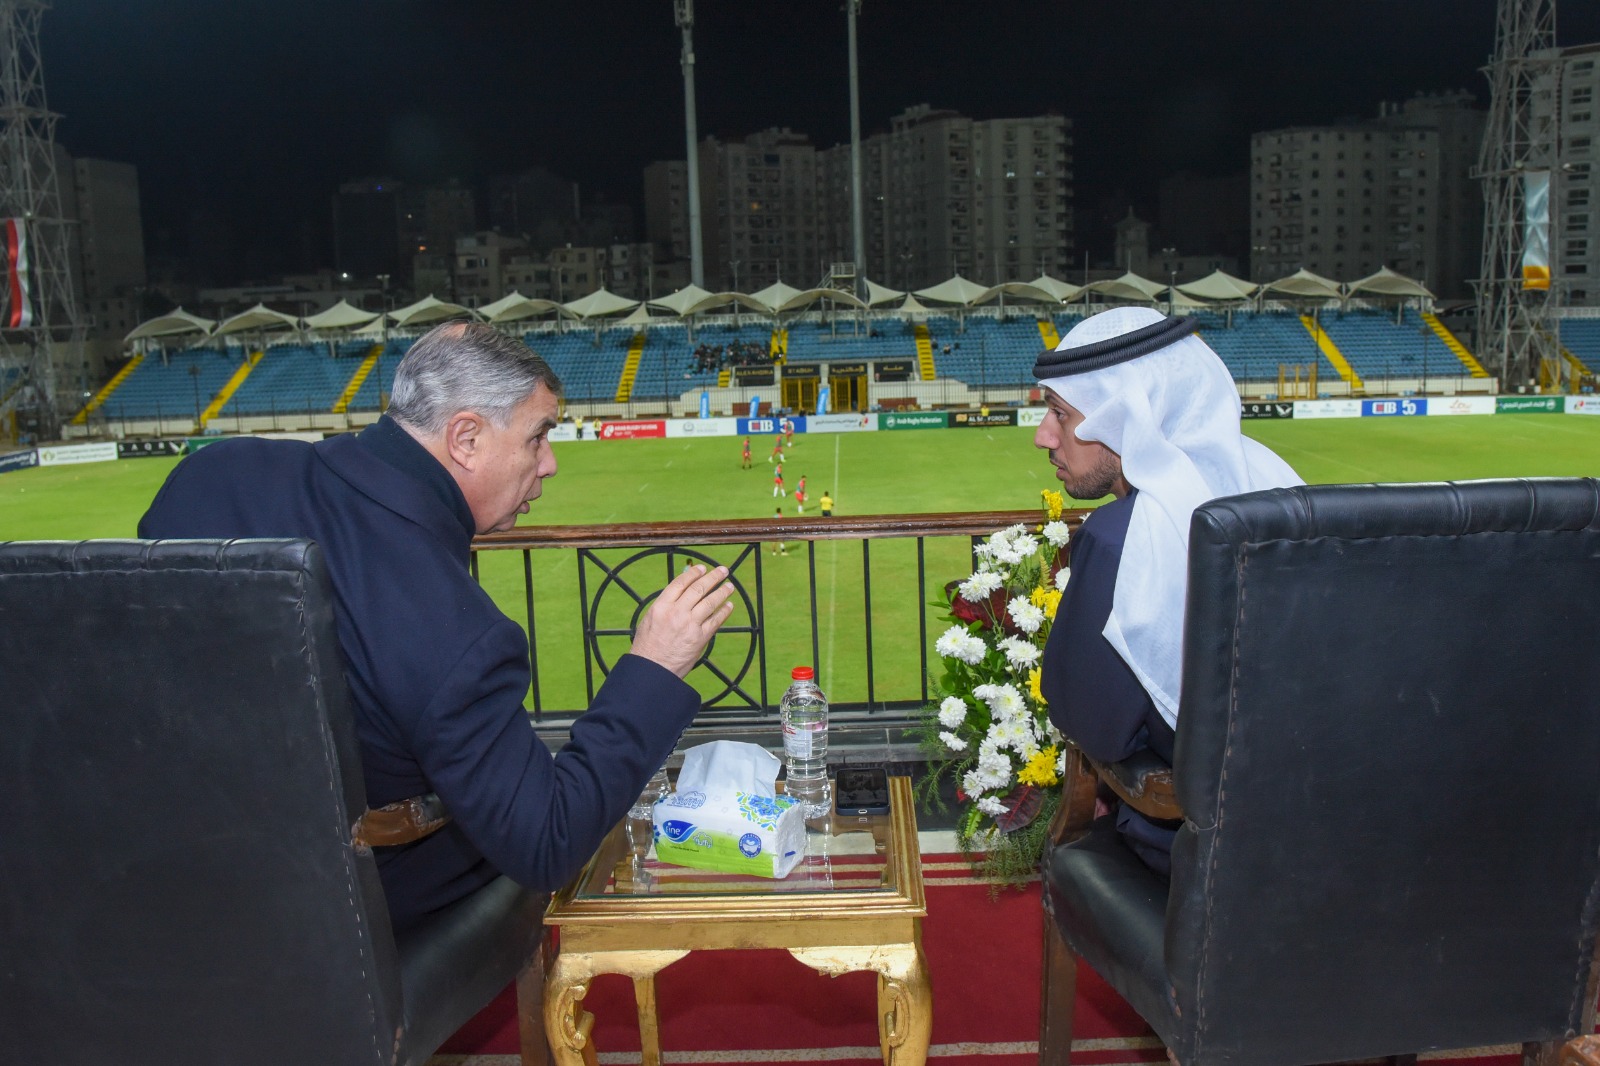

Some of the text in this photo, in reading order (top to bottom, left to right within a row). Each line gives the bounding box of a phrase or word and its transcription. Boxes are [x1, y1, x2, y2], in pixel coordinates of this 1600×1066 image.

[1372, 402, 1397, 414] CIB
[1402, 400, 1416, 415] 50
[748, 419, 774, 432] CIB
[119, 442, 165, 452] SAQR
